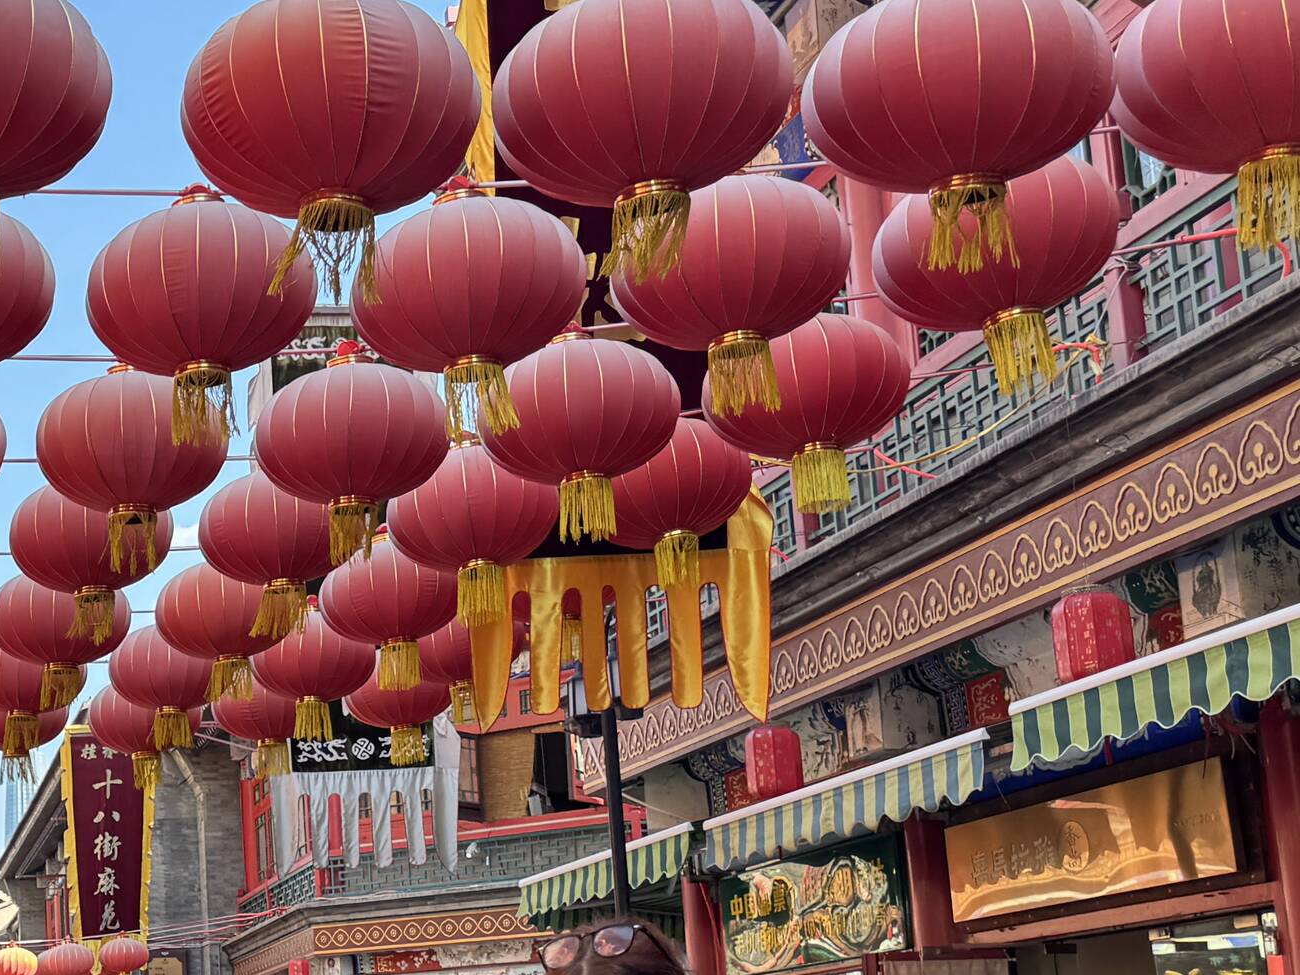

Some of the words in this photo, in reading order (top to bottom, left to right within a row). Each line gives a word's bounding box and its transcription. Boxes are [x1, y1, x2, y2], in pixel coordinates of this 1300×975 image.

[92, 769, 123, 932] 十八街麻花
